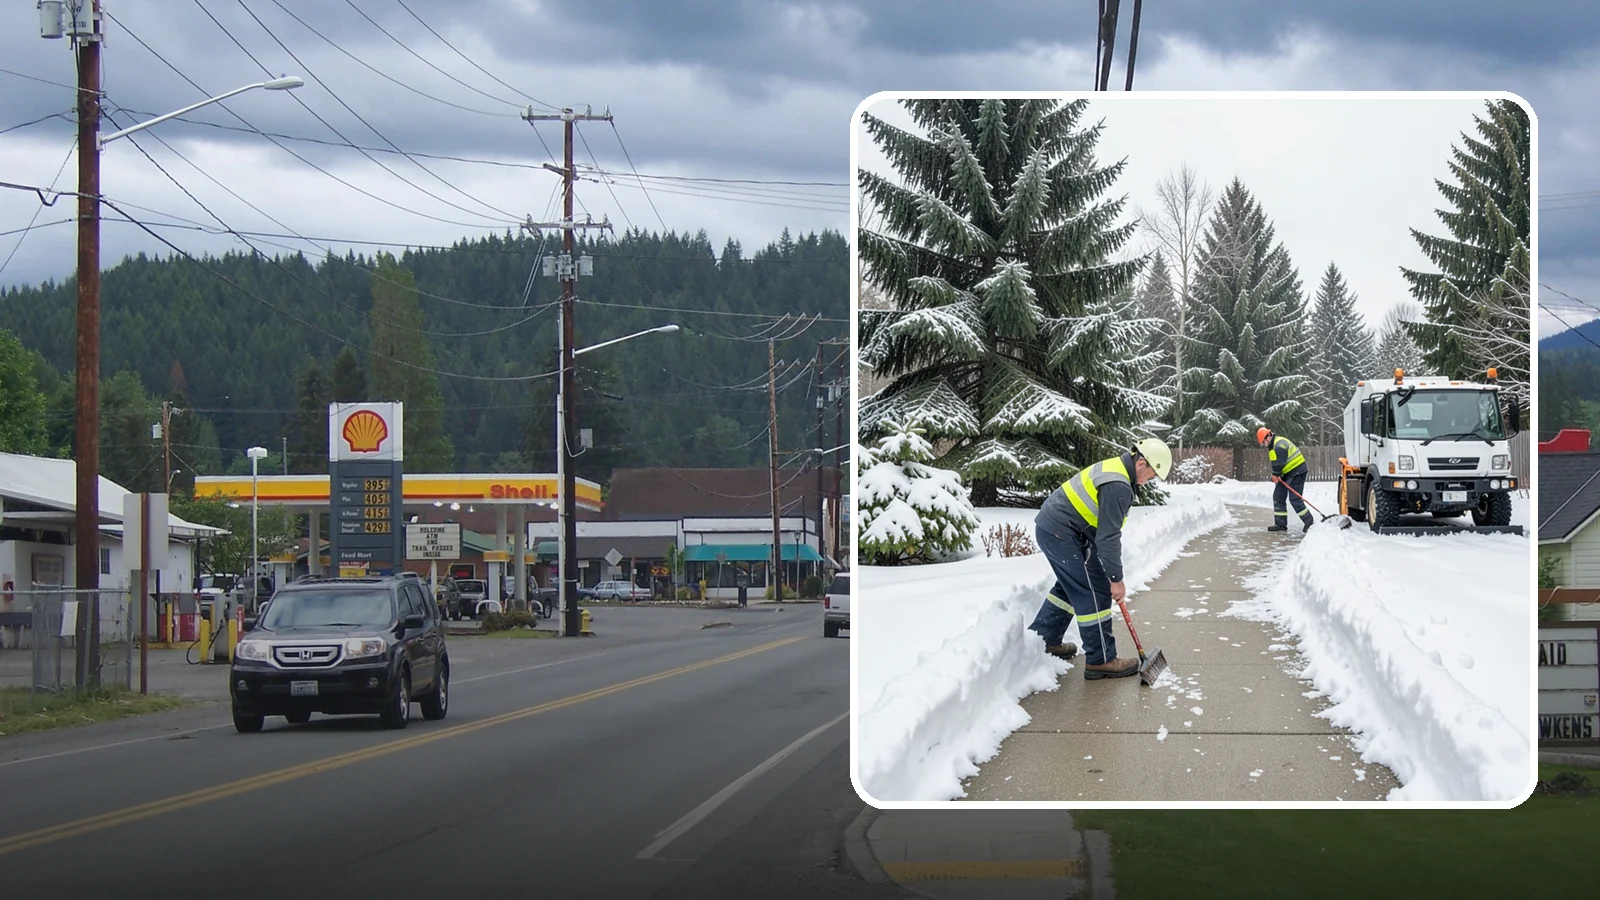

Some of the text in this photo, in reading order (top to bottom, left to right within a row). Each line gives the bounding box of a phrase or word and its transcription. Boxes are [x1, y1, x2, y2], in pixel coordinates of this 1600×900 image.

[365, 480, 383, 490] 395
[490, 484, 547, 499] Shell
[365, 494, 383, 504] 405
[365, 508, 383, 518] 415
[365, 522, 383, 532] 429
[1539, 643, 1566, 666] AID
